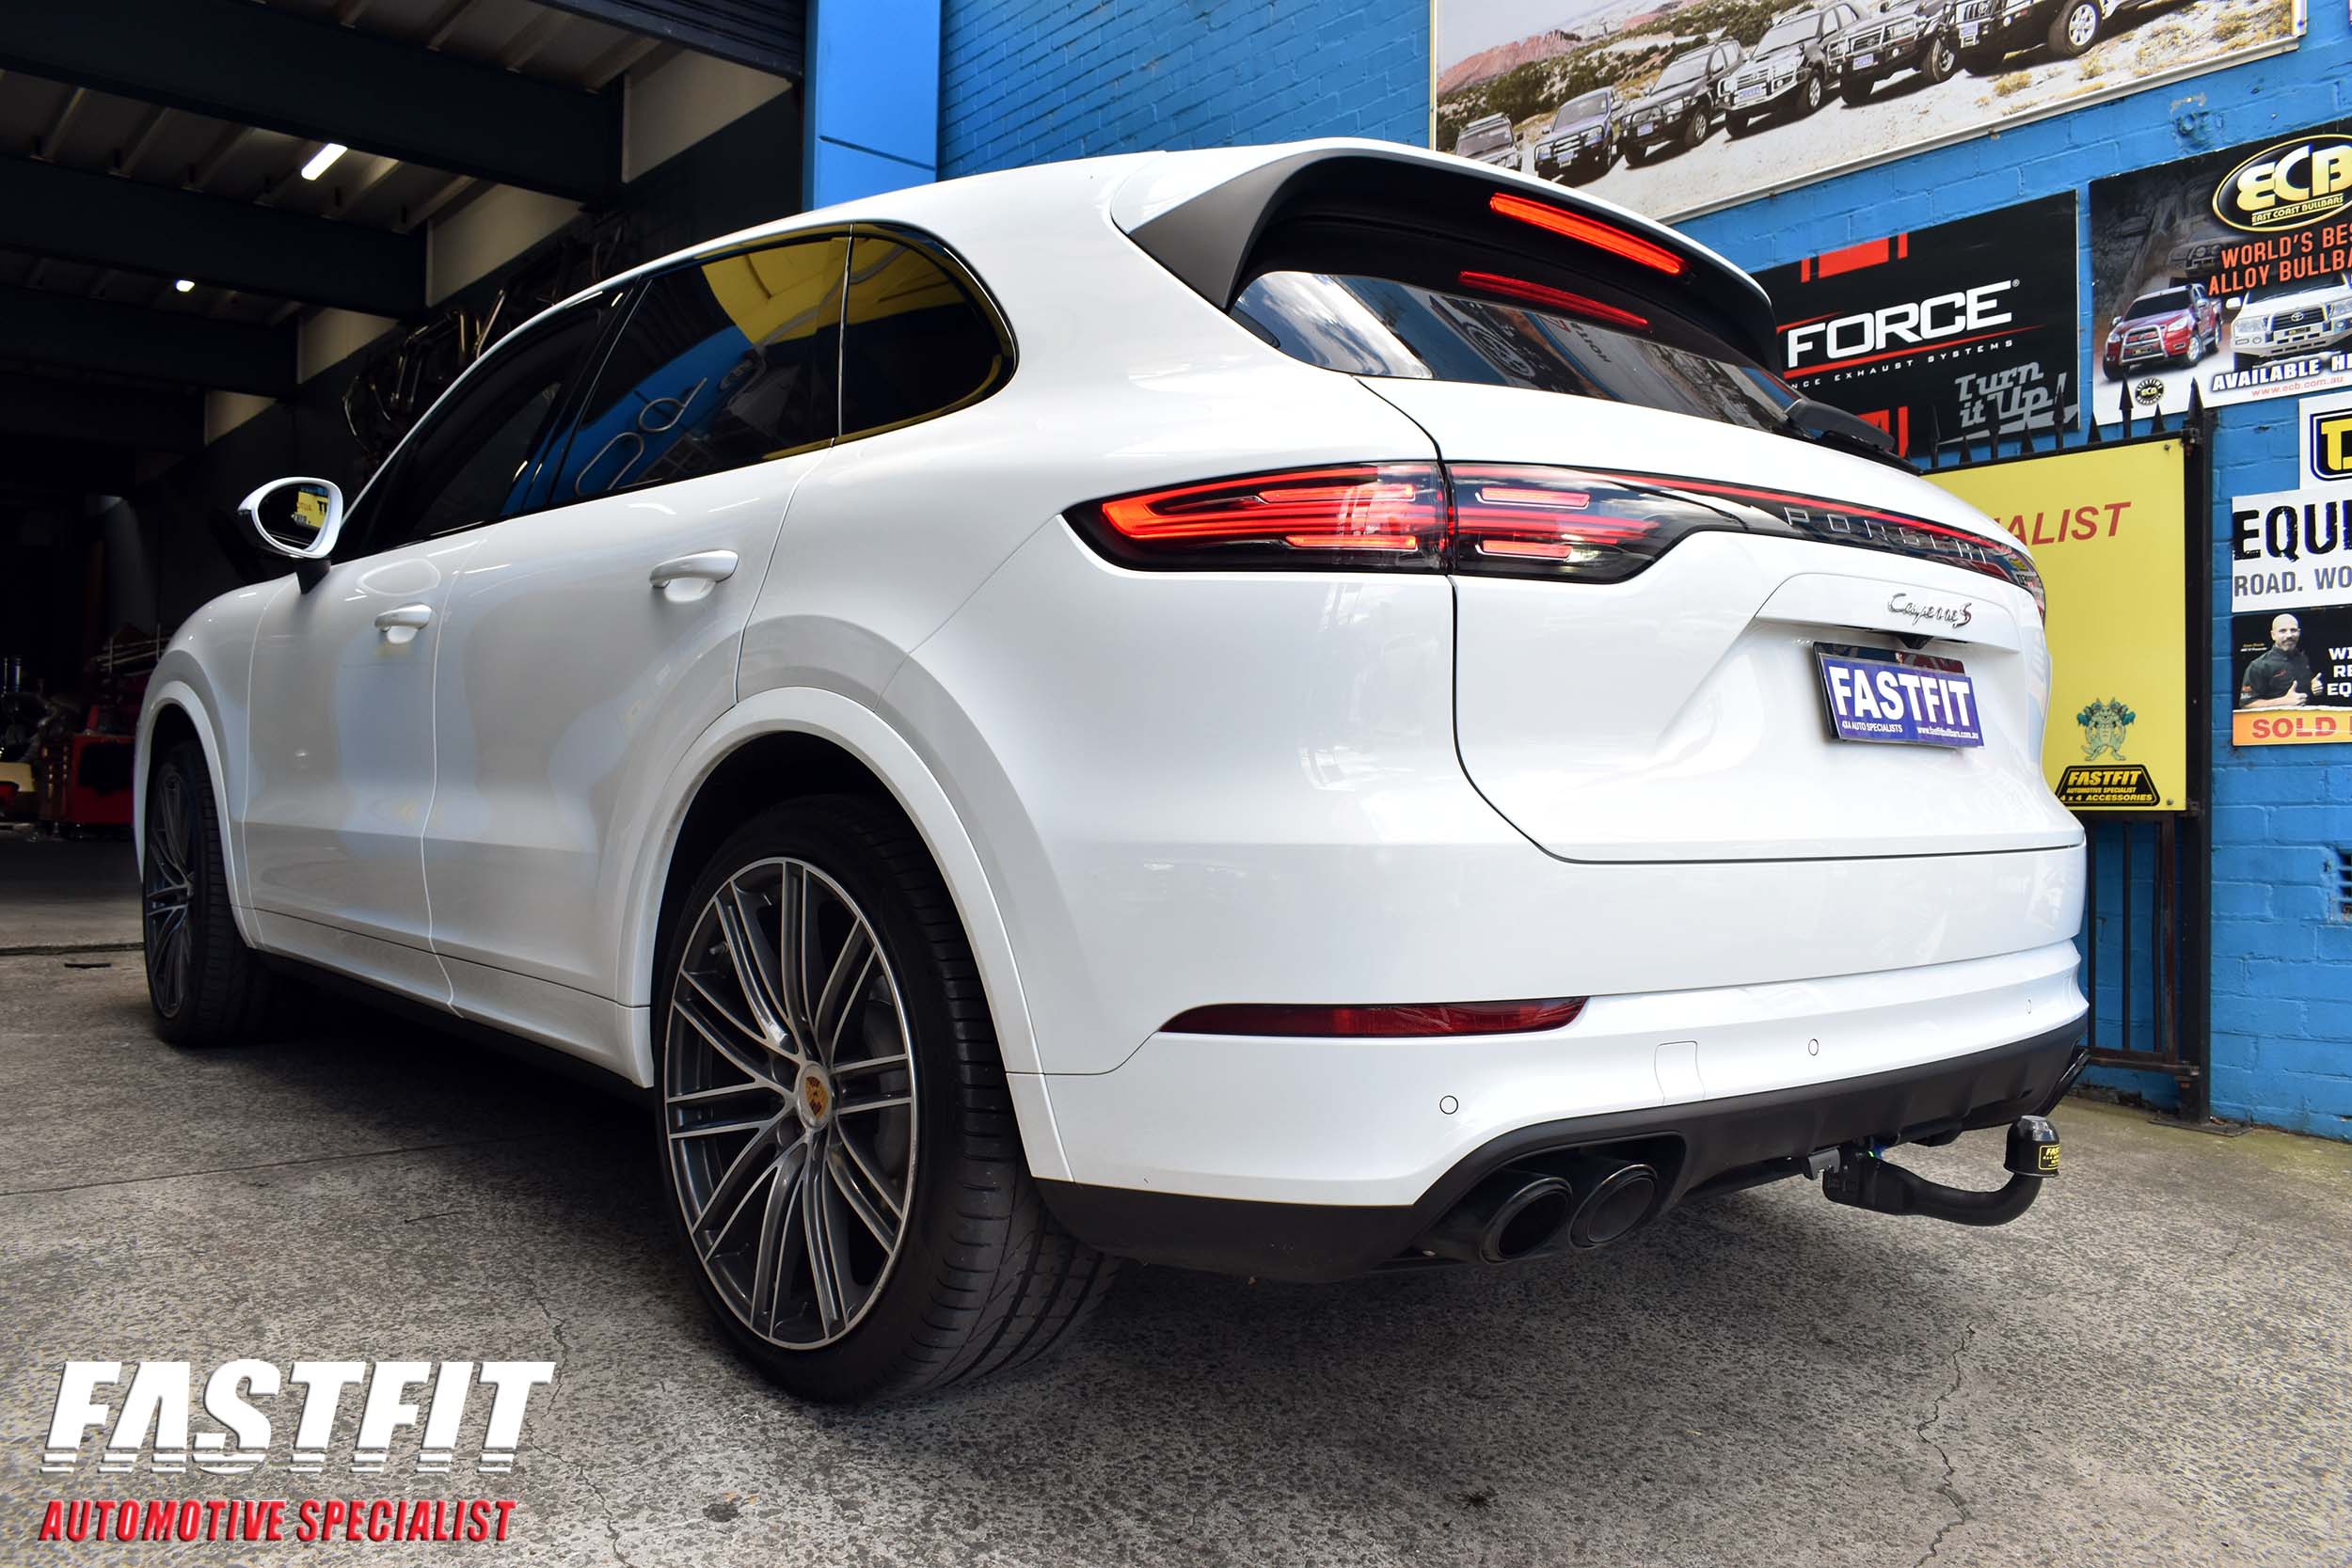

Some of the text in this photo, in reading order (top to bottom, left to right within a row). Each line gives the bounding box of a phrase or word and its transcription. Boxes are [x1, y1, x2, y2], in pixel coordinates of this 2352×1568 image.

[2236, 145, 2352, 211] ECB
[2251, 195, 2344, 224] EAST COAST BULLBARS
[2220, 223, 2352, 270] WORLD'S BE
[2208, 264, 2270, 296] ALLOY
[1788, 279, 2012, 369] FORCE
[1835, 360, 1914, 381] EXHAUST
[1928, 340, 2012, 362] SYSTEMS
[2212, 358, 2321, 391] AVAILABLE
[1955, 361, 2044, 403] Turn
[2251, 376, 2344, 396] www.ecb.com.au
[1960, 399, 1987, 428] it
[1994, 501, 2132, 546] ALIST
[2234, 571, 2303, 597] ROAD.
[1888, 593, 1958, 626] Cayenne
[1829, 666, 1970, 727] FASTFIT
[1851, 721, 1867, 731] AUTO
[1867, 722, 1903, 733] SPECIALISTS
[2252, 716, 2337, 738] SOLD
[2067, 771, 2142, 785] FASTFIT
